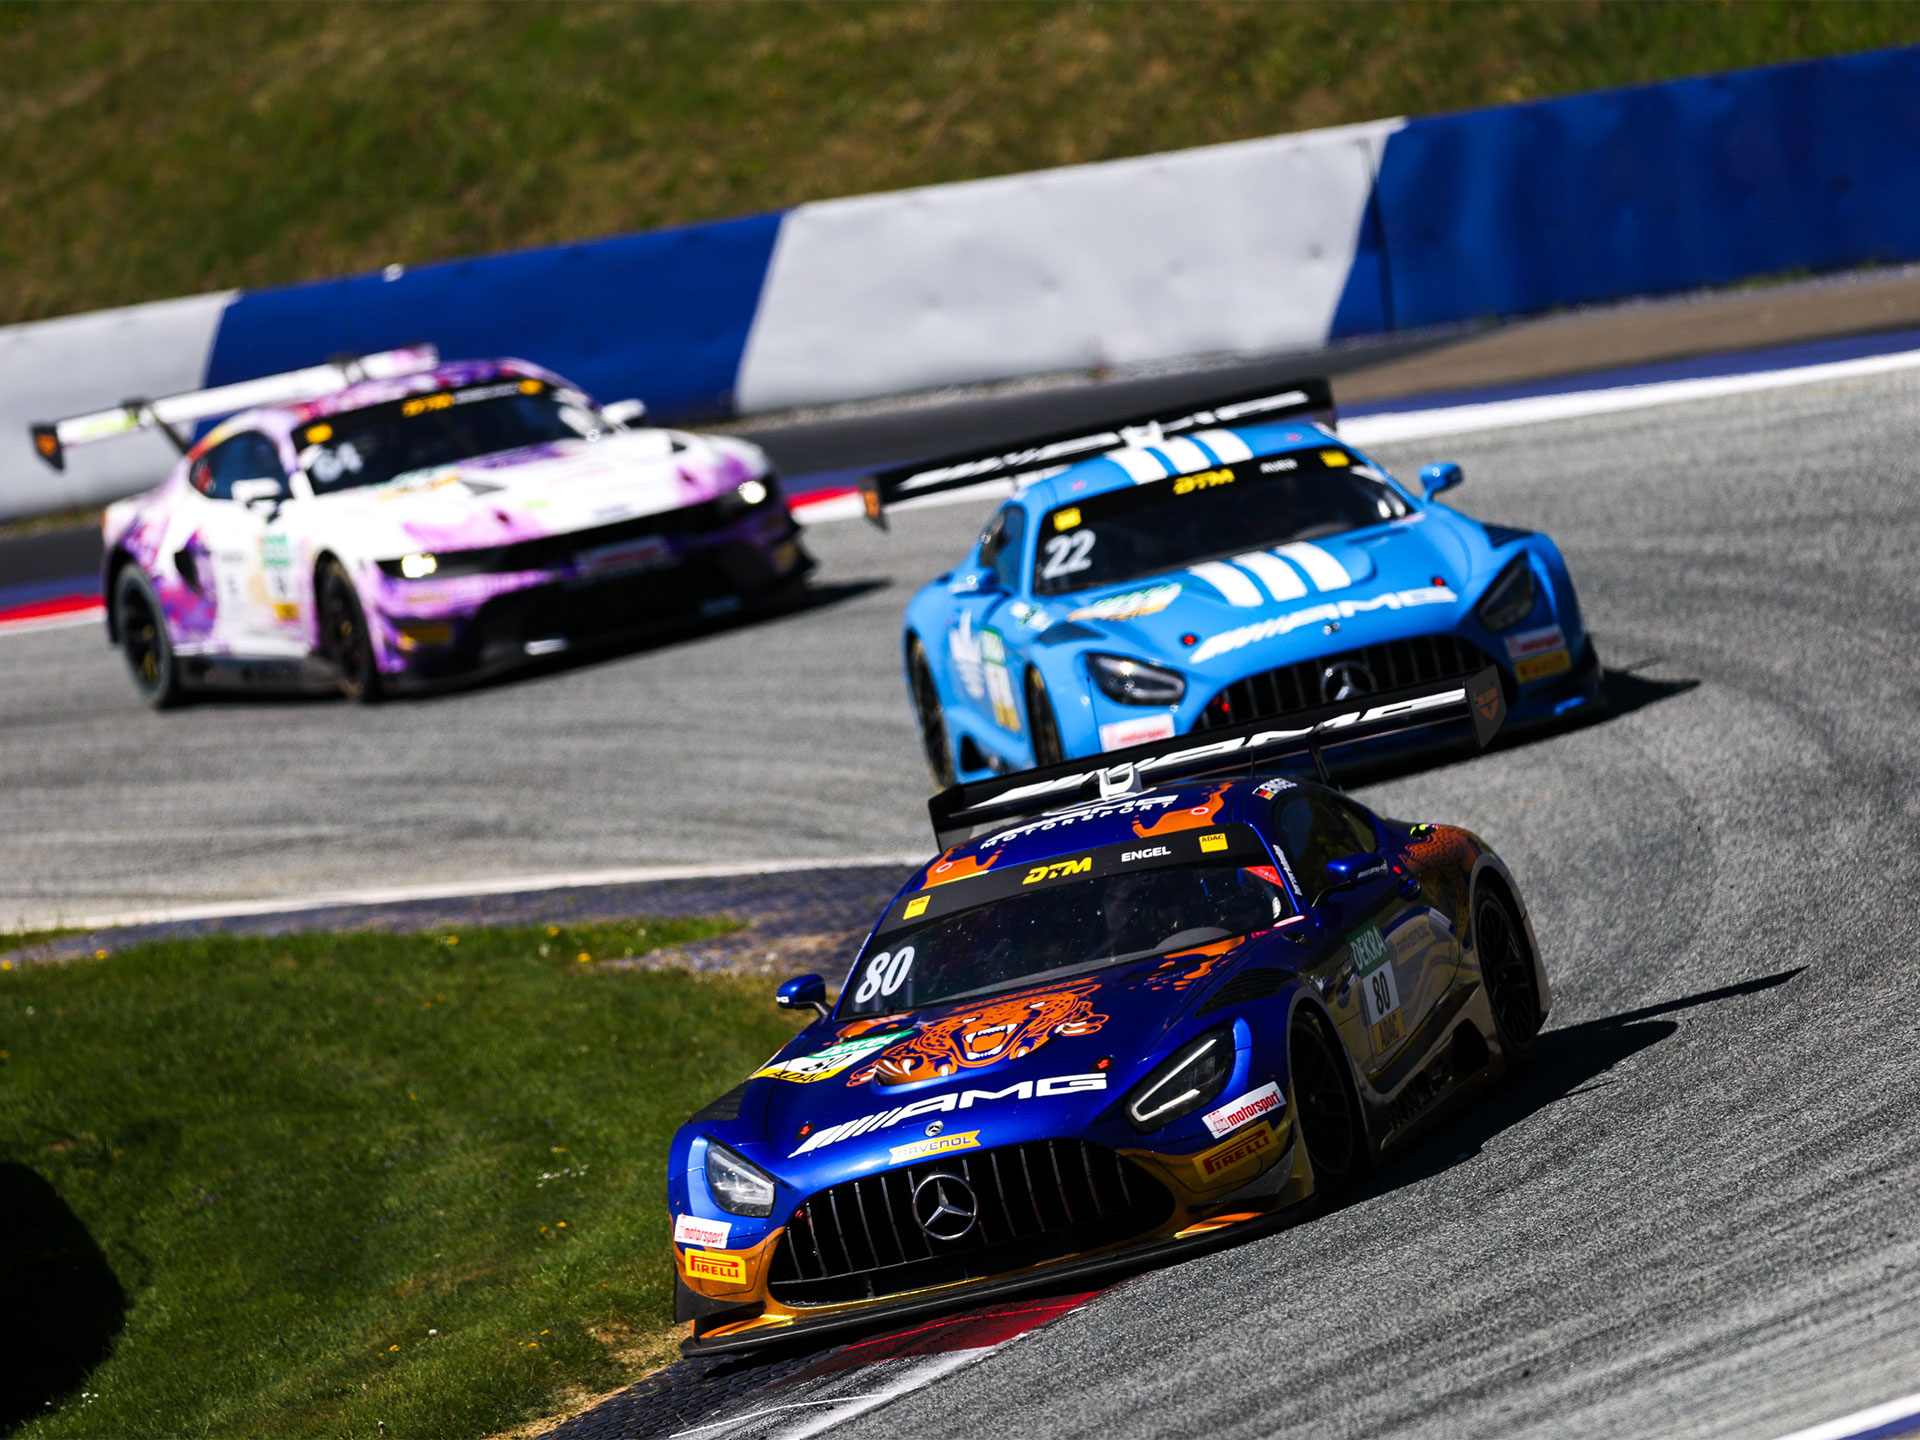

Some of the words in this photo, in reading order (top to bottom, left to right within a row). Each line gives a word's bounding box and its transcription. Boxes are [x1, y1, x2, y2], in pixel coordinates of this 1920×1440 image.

[1172, 468, 1236, 495] DTM
[1042, 528, 1096, 579] 22
[980, 801, 1174, 849] MOTORSPORT
[1201, 834, 1224, 843] ADAC
[1022, 857, 1093, 885] DTM
[1120, 846, 1172, 863] ENGEL
[1349, 925, 1387, 970] DEKRA
[855, 946, 915, 1003] 80
[1372, 971, 1391, 1016] 80
[1379, 1013, 1400, 1046] ADAC
[1226, 1090, 1281, 1127] motorsport
[898, 1136, 972, 1157] RAVENOL
[1202, 1128, 1270, 1176] PIRELLI
[683, 1227, 724, 1245] motorsport
[689, 1255, 739, 1278] PIRELLI
